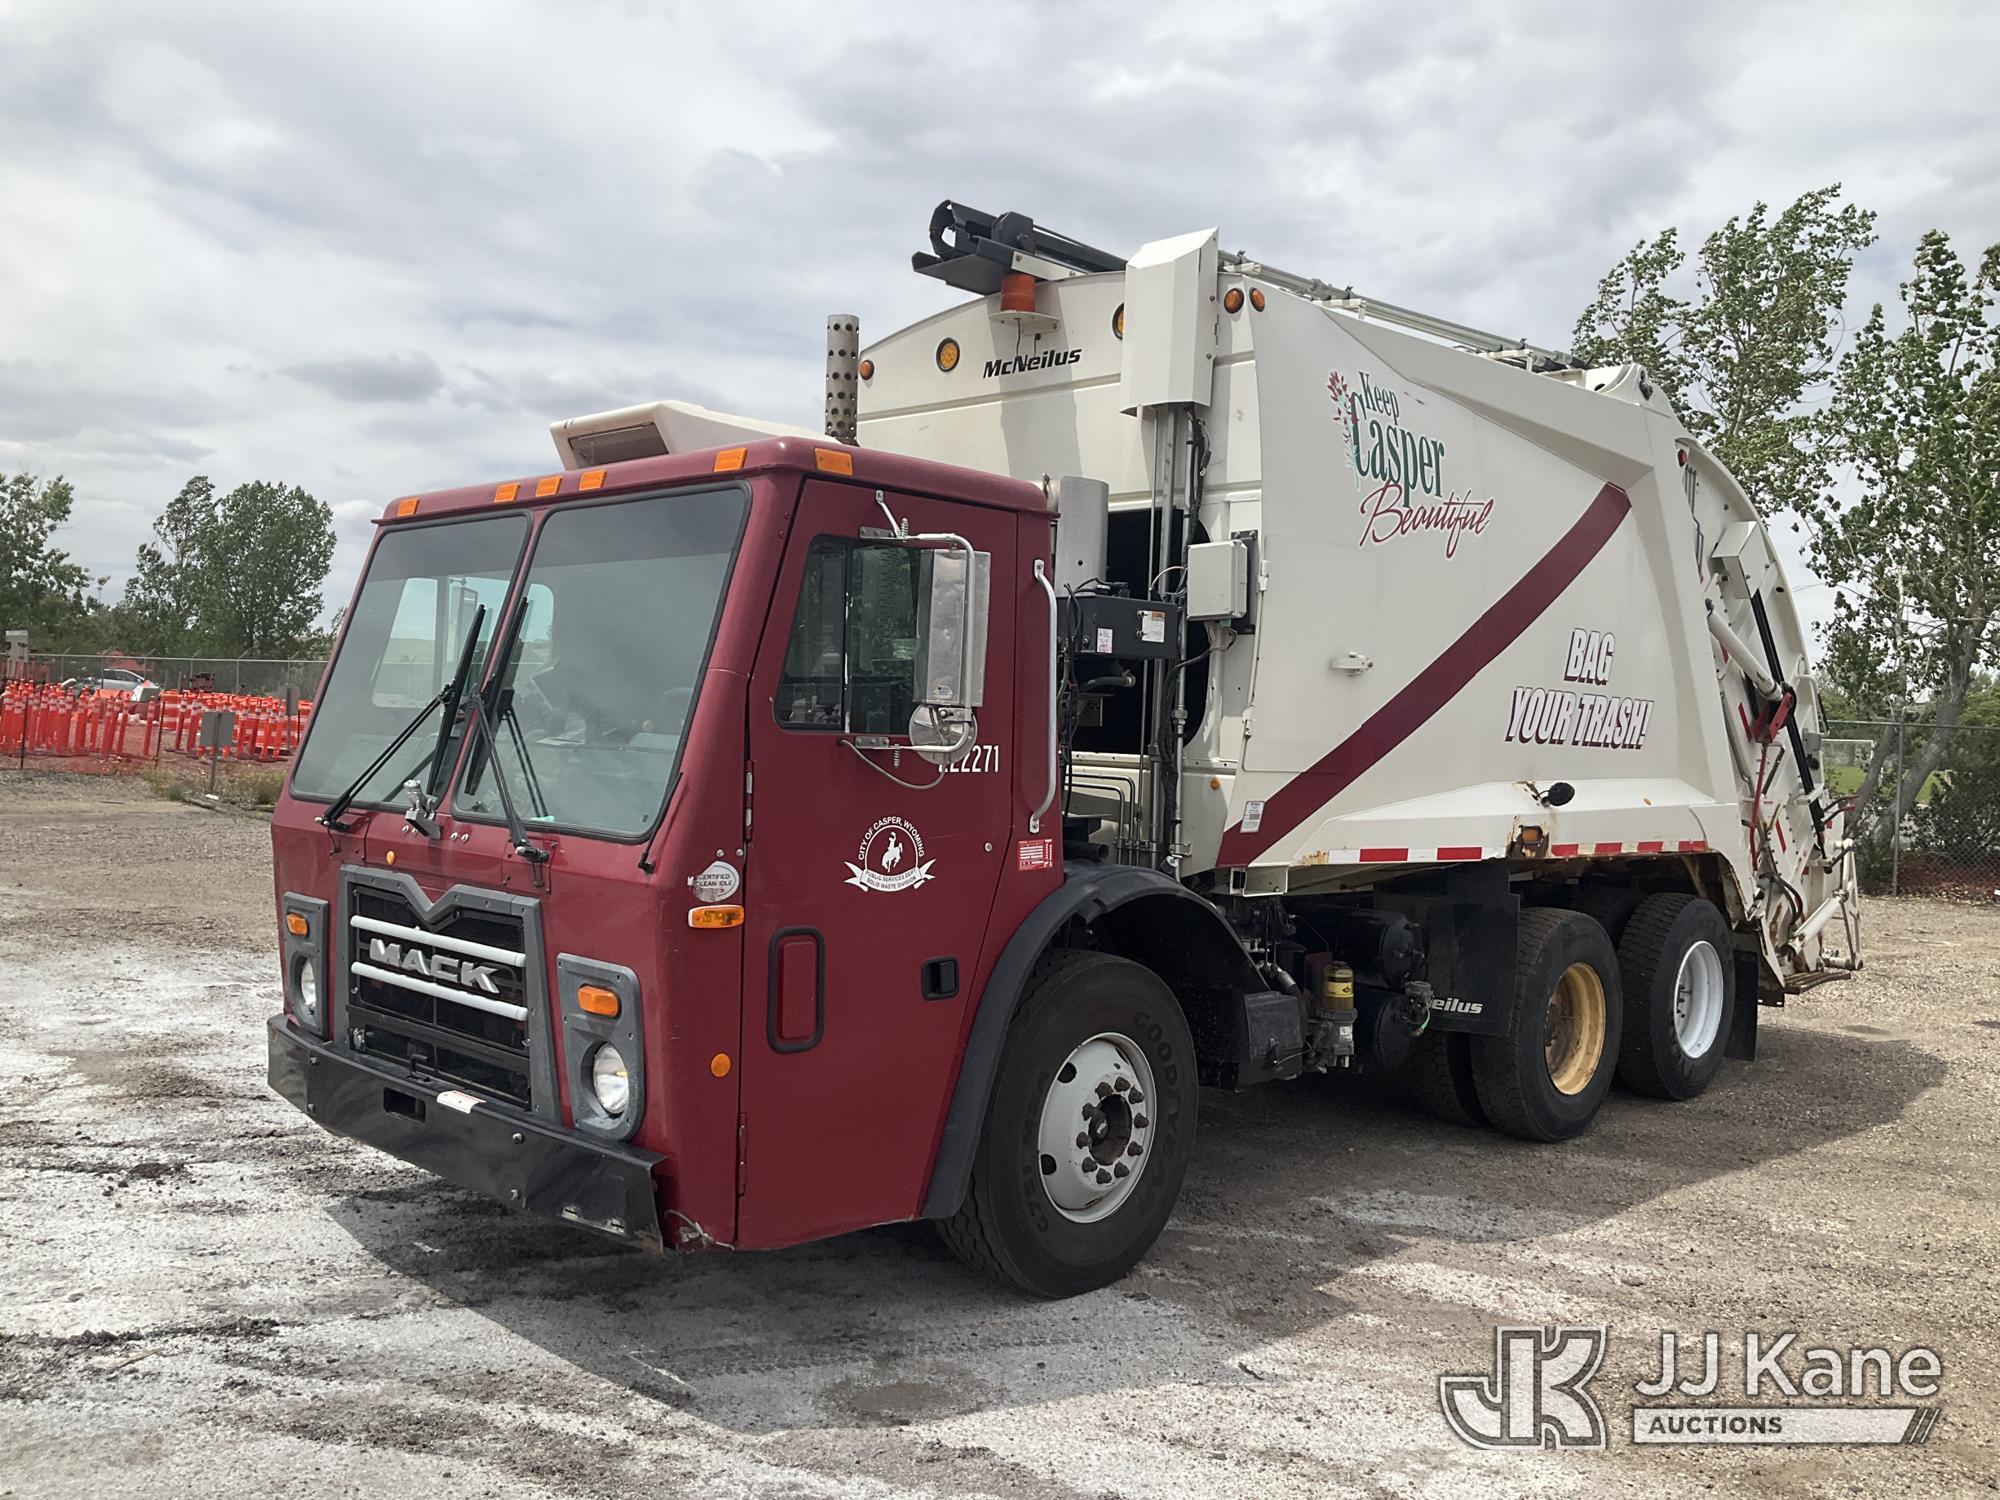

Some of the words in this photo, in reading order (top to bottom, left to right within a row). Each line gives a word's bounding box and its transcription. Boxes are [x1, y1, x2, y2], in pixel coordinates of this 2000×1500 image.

[982, 348, 1083, 379] McNeilus
[1358, 371, 1400, 426] Keep
[1350, 391, 1445, 508] Casper
[1359, 480, 1495, 559] Beautiful
[1563, 627, 1616, 686] BAG
[1504, 685, 1577, 745] YOUR
[1571, 692, 1655, 750] TRASH!
[938, 744, 999, 773] 2271
[858, 839, 868, 860] CITY
[864, 827, 874, 840] OF
[873, 816, 903, 830] CASPER,
[903, 820, 925, 857] WYOMING
[369, 937, 500, 994] MACK
[1431, 996, 1484, 1015] eilus
